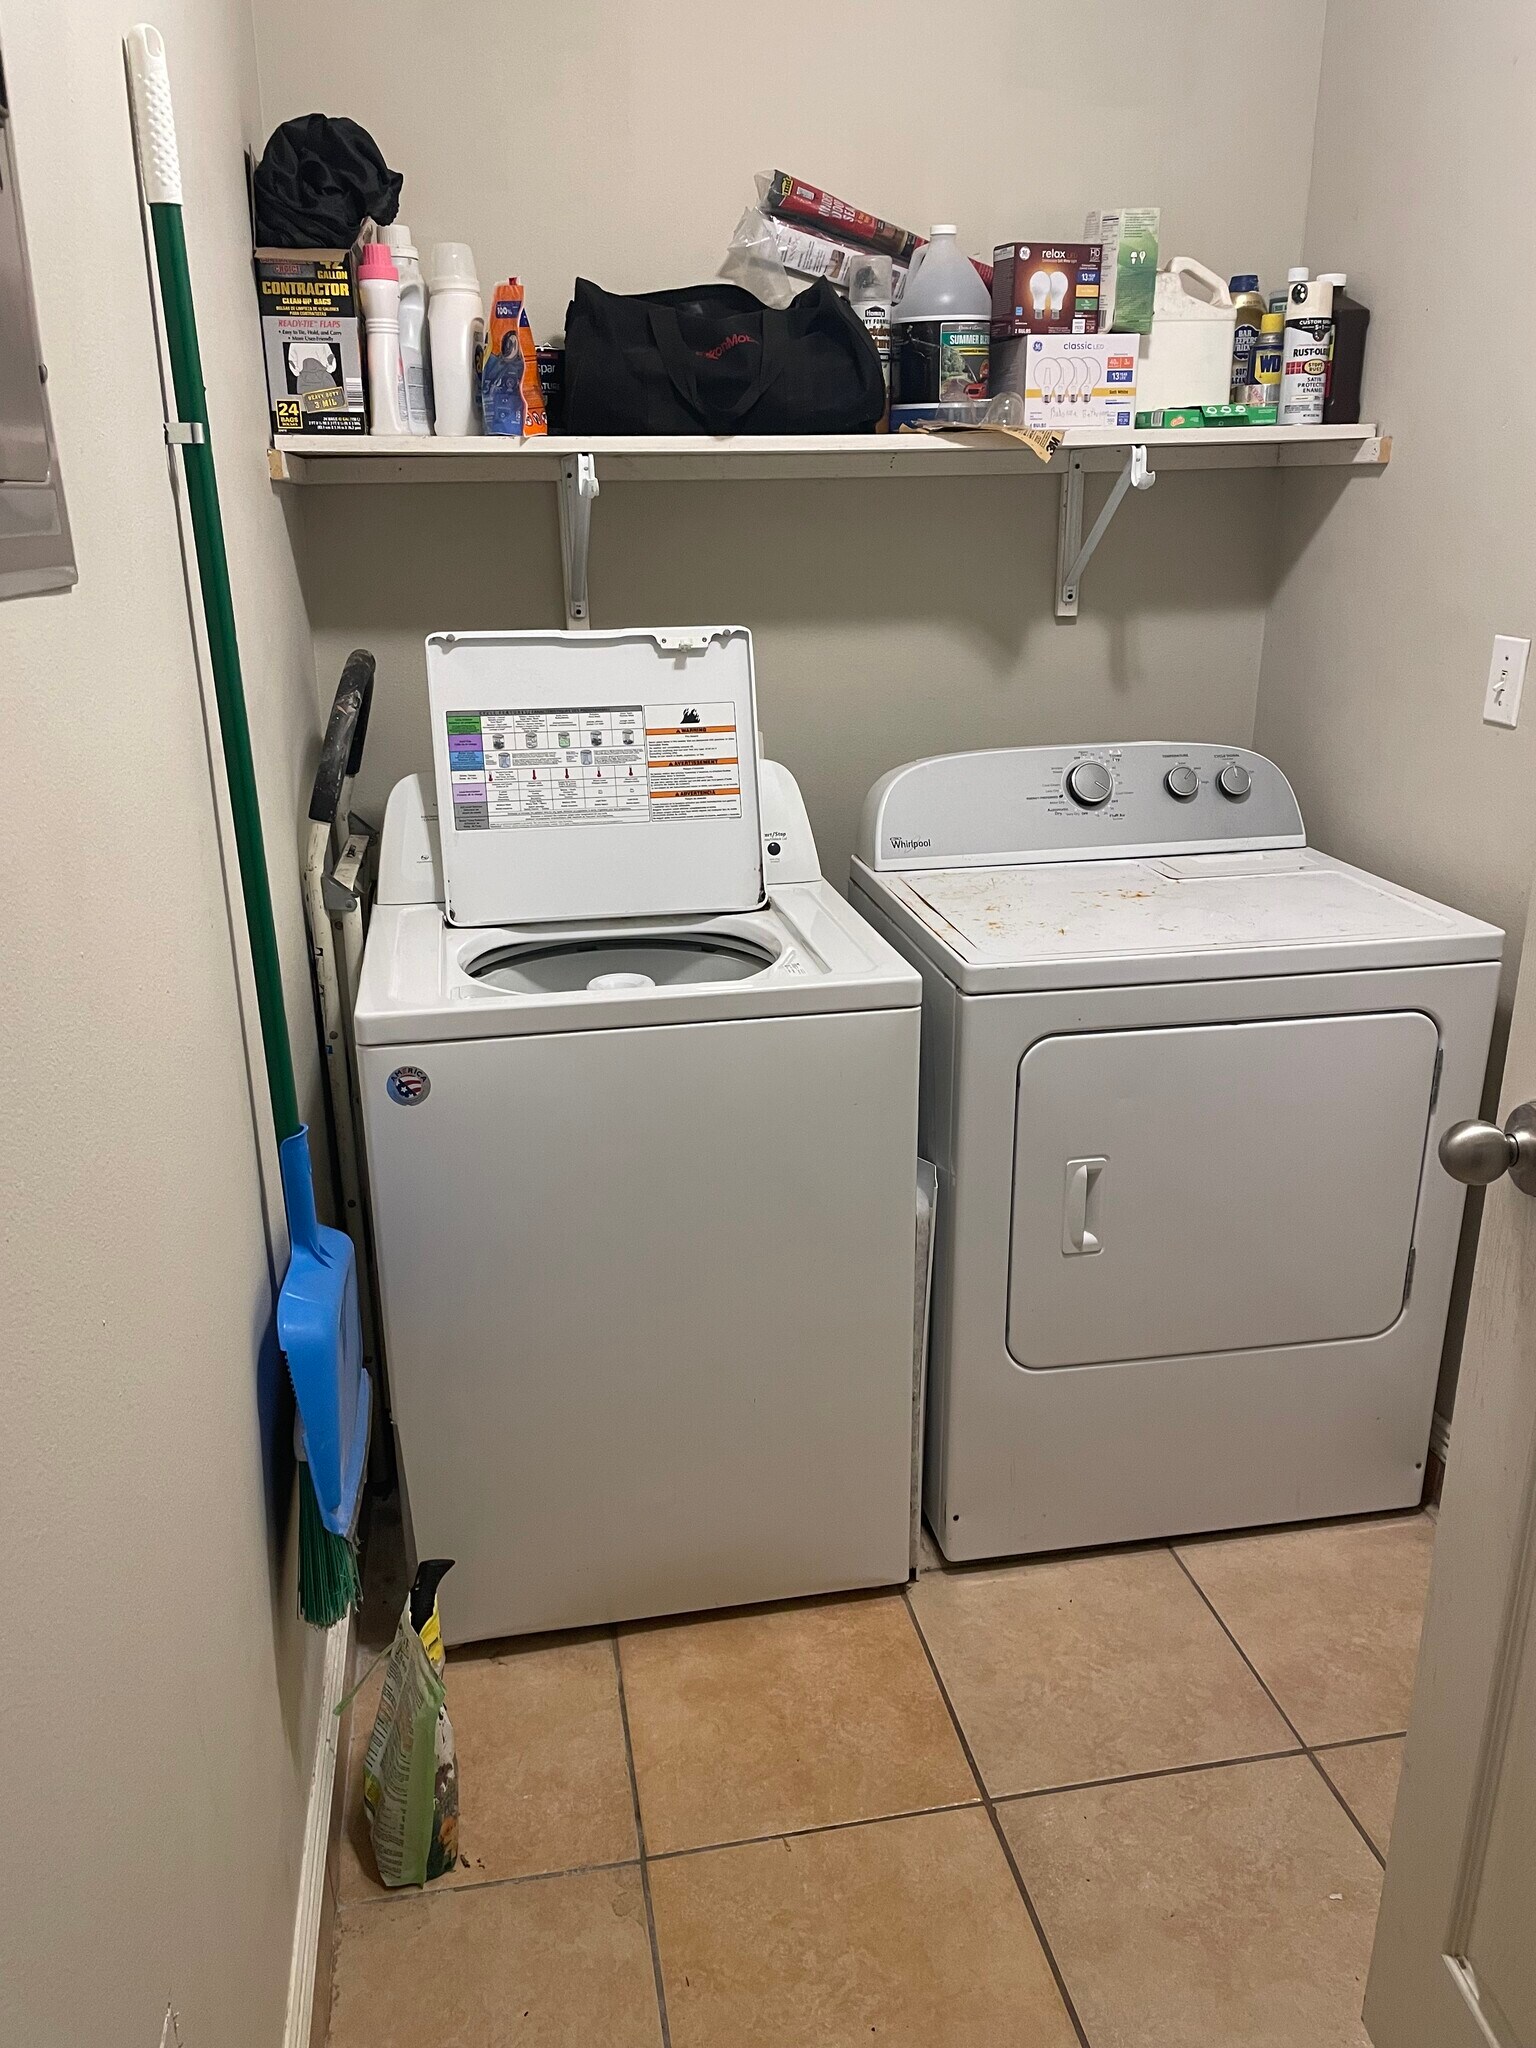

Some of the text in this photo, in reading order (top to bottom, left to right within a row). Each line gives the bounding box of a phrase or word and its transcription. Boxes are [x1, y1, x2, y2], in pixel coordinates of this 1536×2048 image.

[1042, 248, 1066, 259] relax
[317, 270, 348, 280] GALLON
[261, 281, 350, 296] CONTRACTOR
[281, 297, 332, 306] CLEAN-UP BAGS
[319, 319, 341, 328] FLAPS
[1238, 329, 1252, 337] BAR
[949, 334, 980, 345] SUMMER
[1063, 342, 1093, 350] classic
[1111, 372, 1120, 381] 13
[278, 402, 300, 416] 24
[314, 398, 338, 409] 3 MIL
[1046, 436, 1061, 456] 3M
[890, 838, 931, 850] Whirlpool
[390, 1066, 427, 1083] AMERICA
